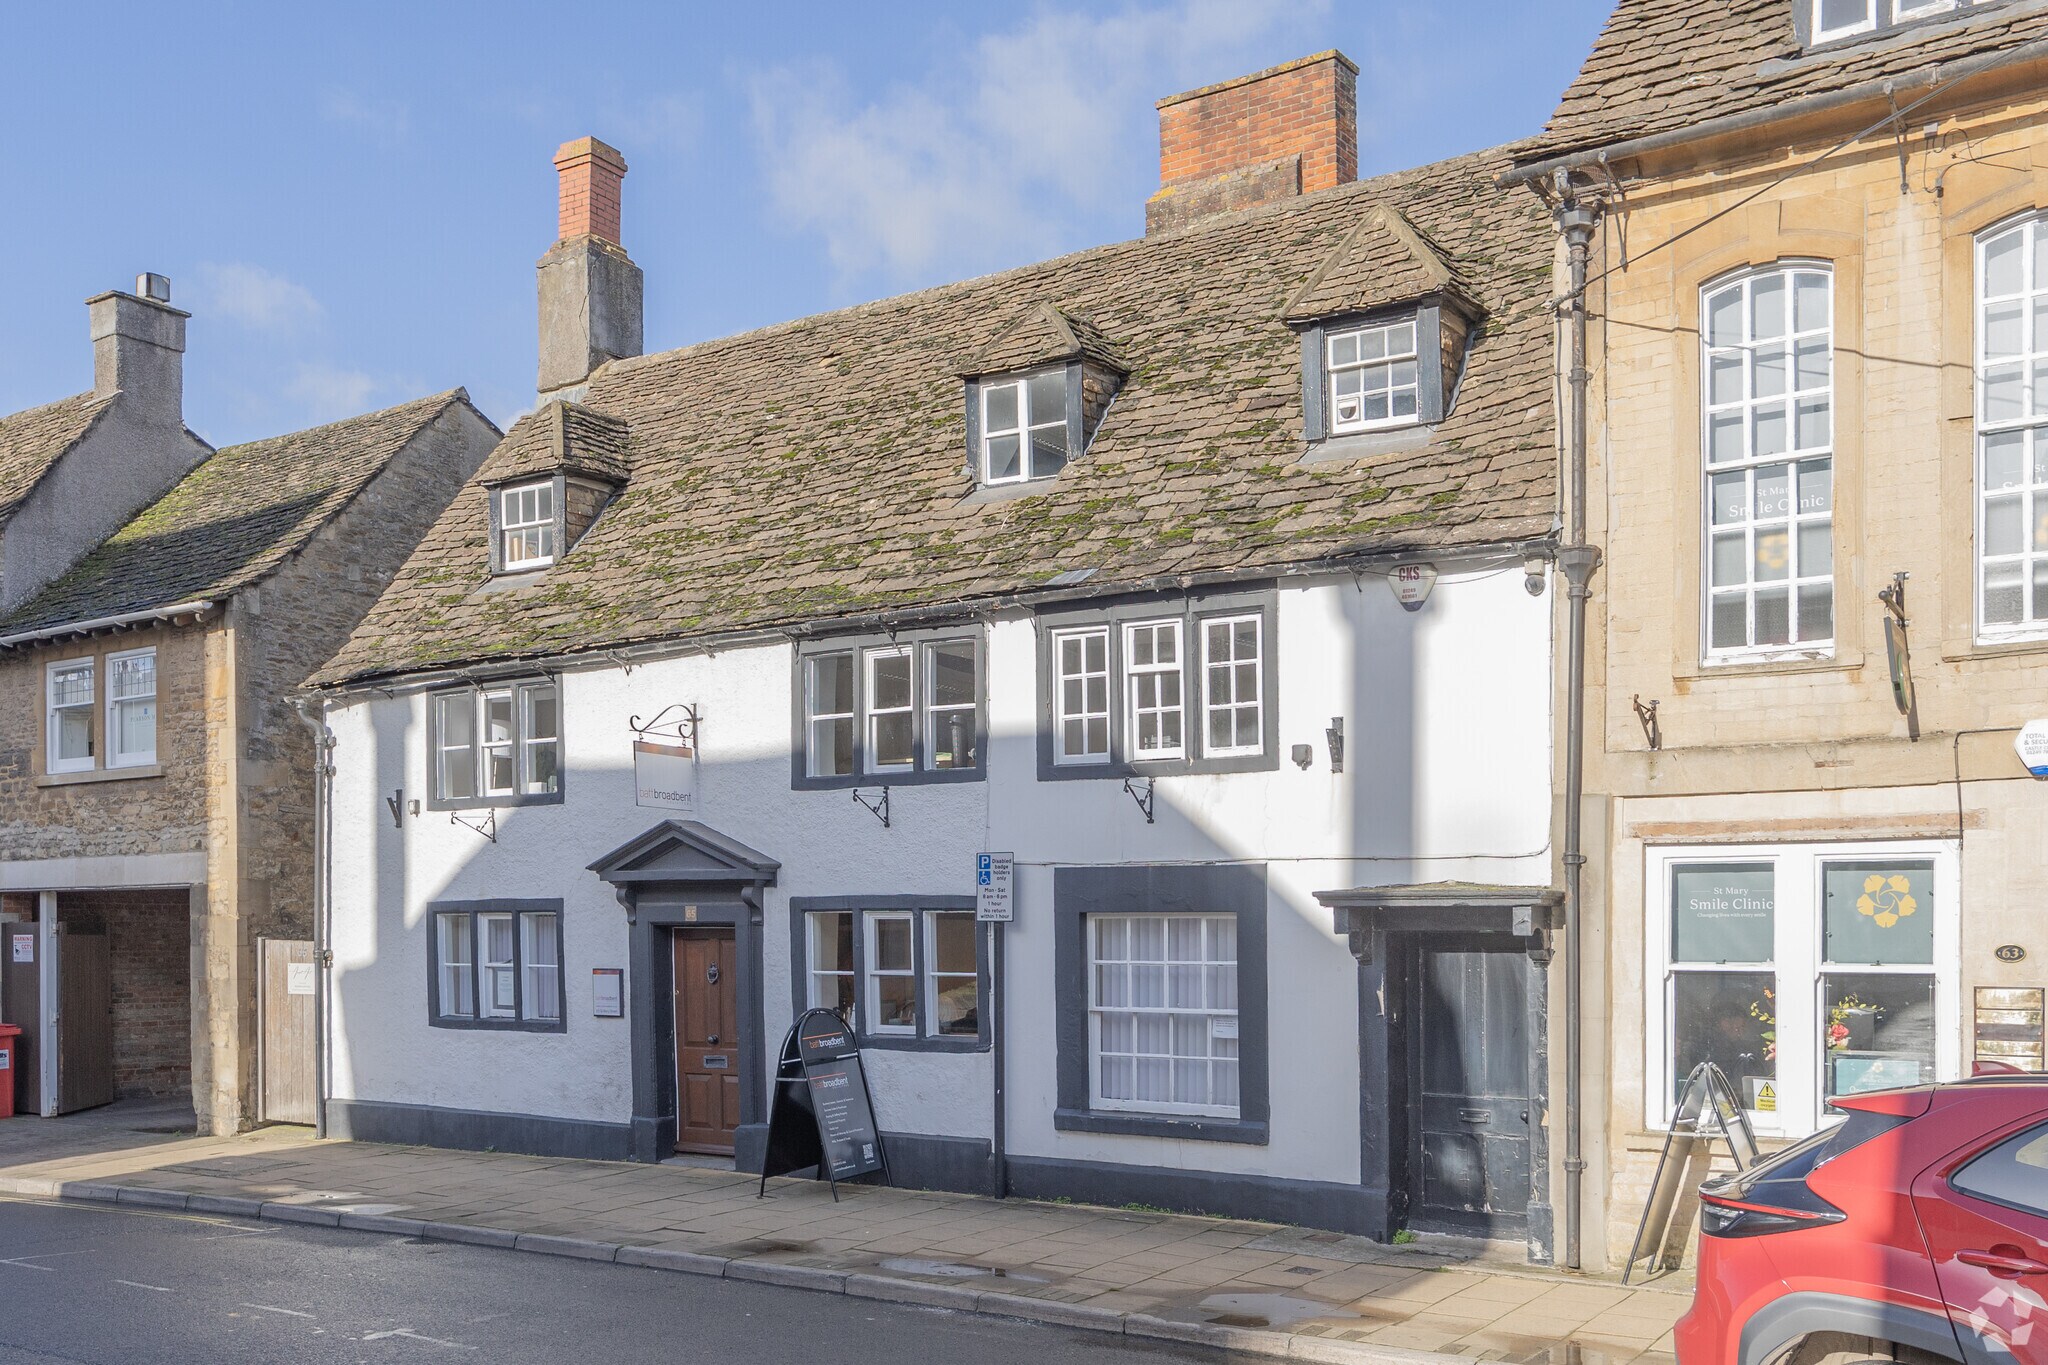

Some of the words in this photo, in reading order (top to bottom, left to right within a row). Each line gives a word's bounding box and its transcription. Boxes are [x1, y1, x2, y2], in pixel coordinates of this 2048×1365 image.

[1756, 488, 1767, 498] St
[1713, 886, 1723, 895] St
[1725, 887, 1749, 896] Mary
[1689, 898, 1729, 910] Smile
[1732, 897, 1774, 910] Clinic
[2001, 948, 2020, 959] 63
